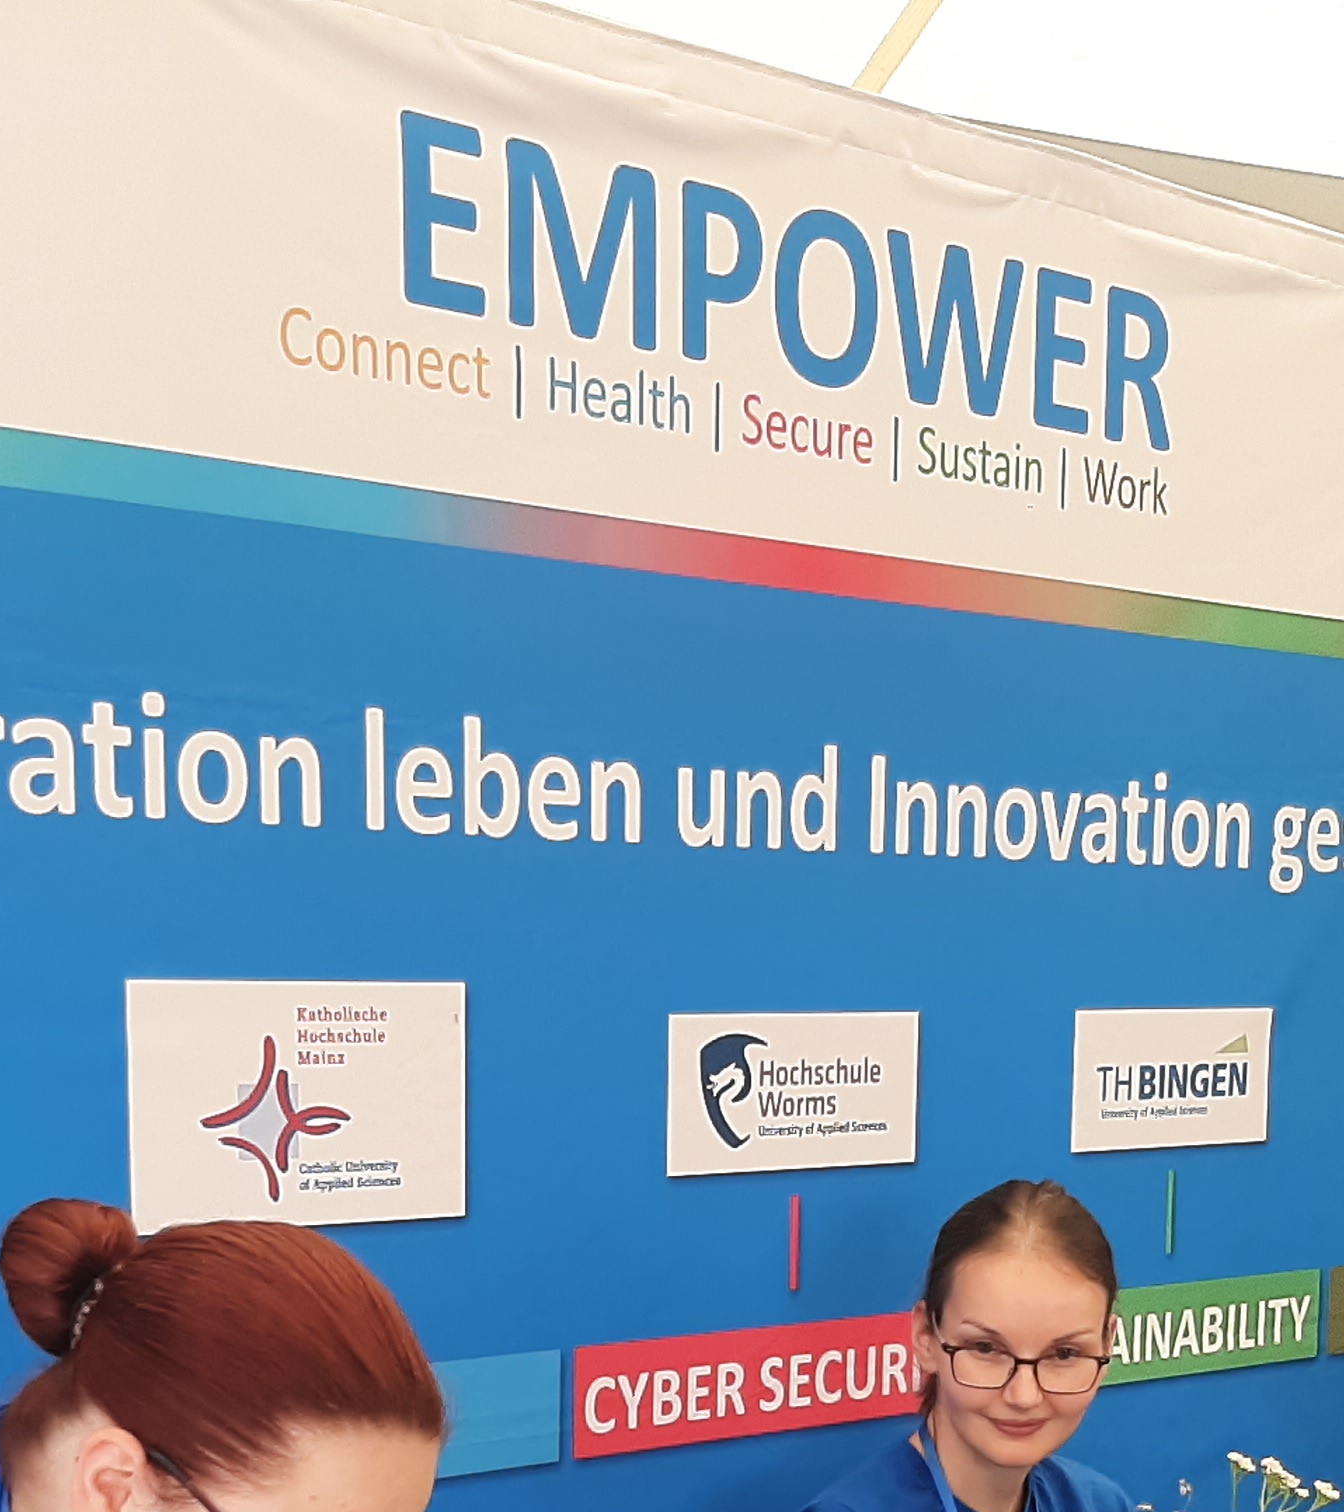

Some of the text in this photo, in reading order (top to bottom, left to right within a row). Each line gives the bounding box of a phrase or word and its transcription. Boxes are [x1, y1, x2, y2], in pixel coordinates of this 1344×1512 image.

[400, 109, 1170, 451] EMPOWER
[279, 306, 1170, 517] Connect Health Secure Sustain Work
[363, 706, 642, 843] leben
[676, 744, 838, 853] und
[869, 754, 1252, 870] Innovation
[296, 1006, 388, 1023] Katholische
[296, 1028, 387, 1044] Hochschule
[297, 1050, 346, 1065] Mainz
[759, 1056, 881, 1088] Hochschule
[1096, 1061, 1249, 1102] TH BINGEN
[758, 1091, 837, 1118] Worms
[1110, 1294, 1312, 1366] AINABILITY
[584, 1361, 747, 1436] CYBER
